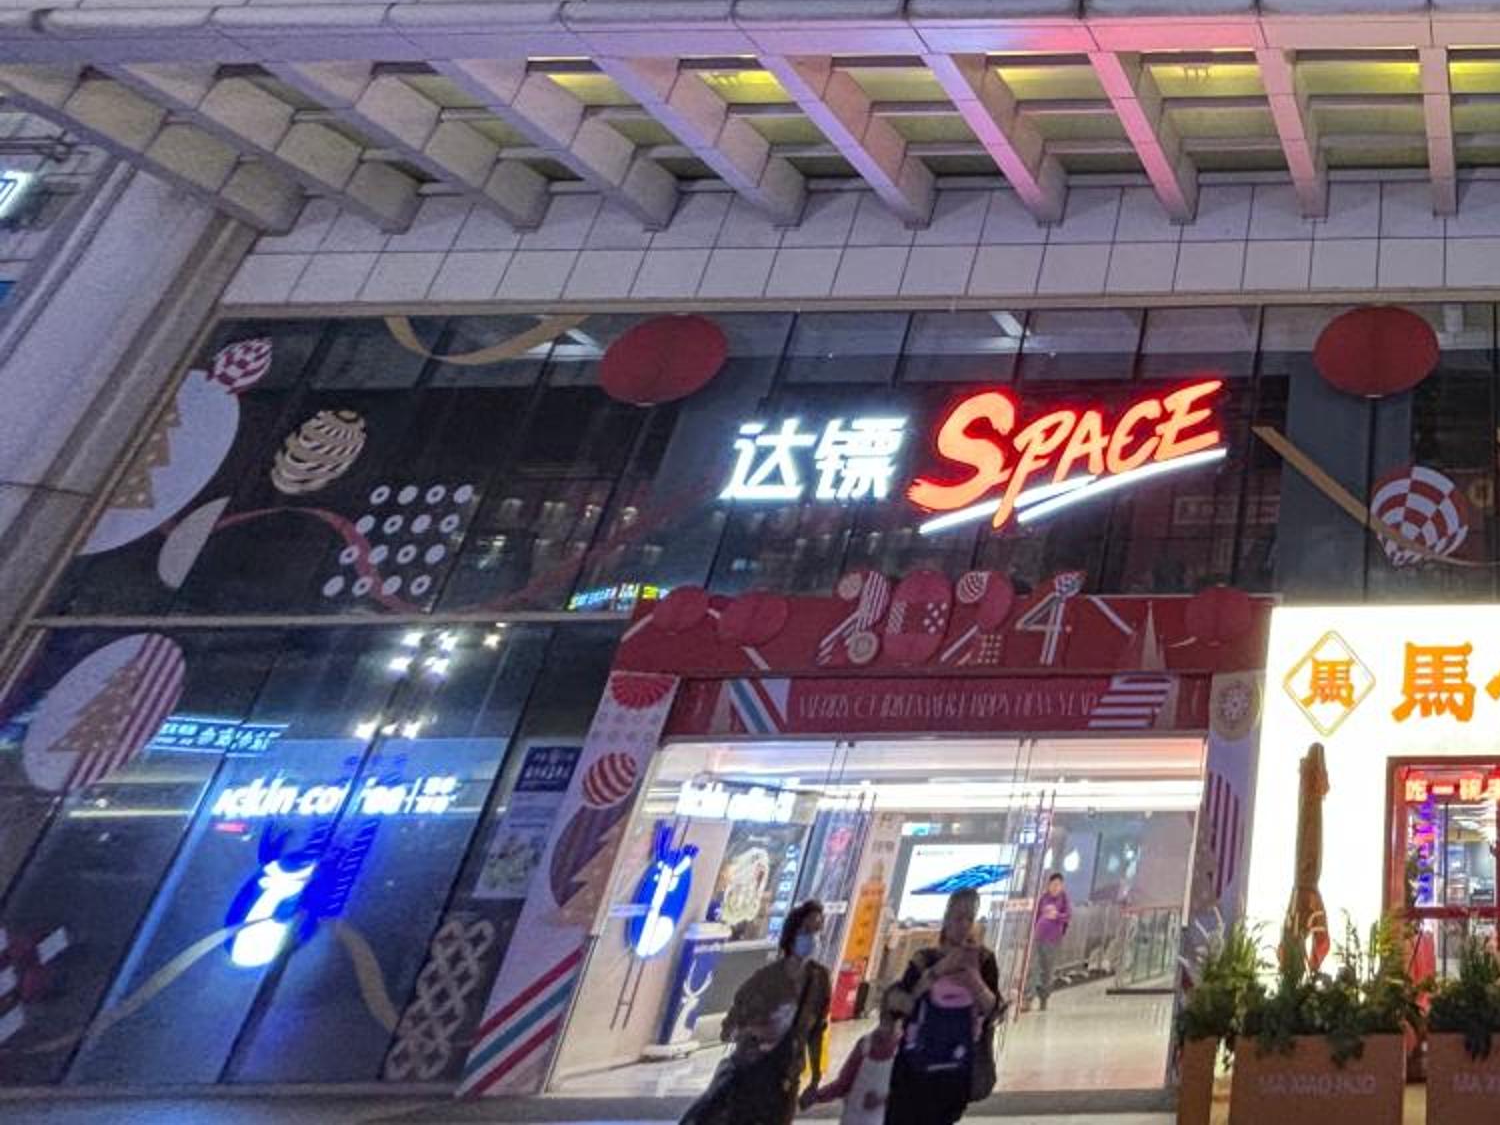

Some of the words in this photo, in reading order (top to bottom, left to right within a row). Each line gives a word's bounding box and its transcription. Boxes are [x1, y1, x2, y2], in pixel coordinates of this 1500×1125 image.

[720, 416, 908, 501] 达镖
[906, 380, 1223, 529] SPACE
[815, 569, 1087, 667] 2024
[1304, 658, 1357, 708] 馬
